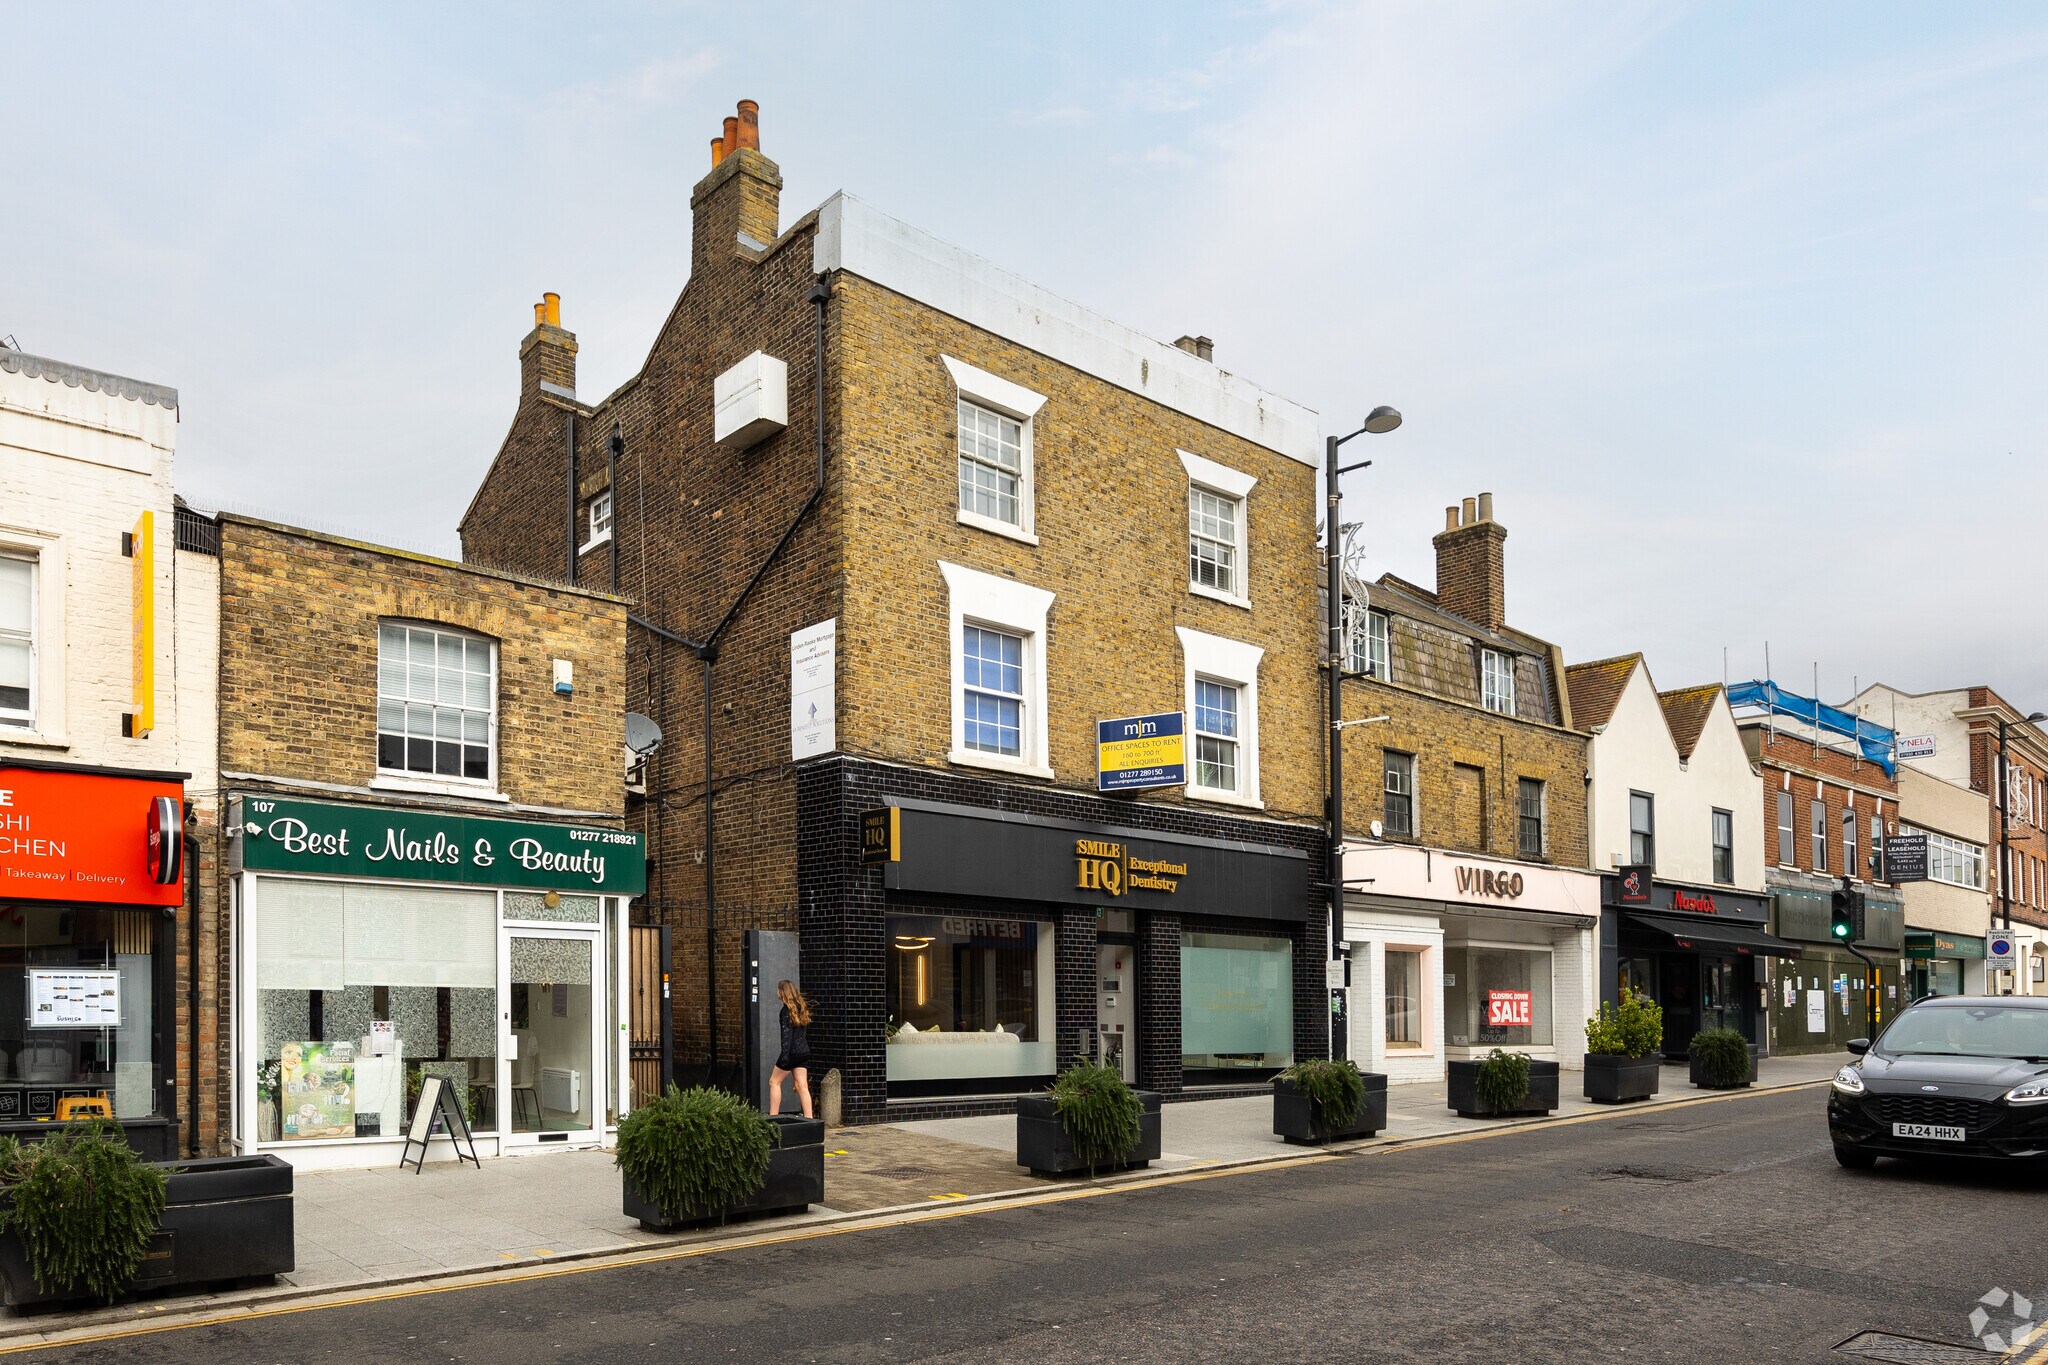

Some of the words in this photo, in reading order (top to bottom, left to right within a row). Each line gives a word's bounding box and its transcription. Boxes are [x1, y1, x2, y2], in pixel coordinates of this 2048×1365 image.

[1102, 744, 1124, 752] OFFICE
[1126, 742, 1150, 750] SPACES
[1163, 738, 1181, 746] RENT
[1907, 738, 1932, 747] NELA
[1119, 760, 1129, 768] ALL
[1131, 757, 1164, 767] ENQUIRIES
[1120, 770, 1138, 778] 01277
[1140, 768, 1163, 777] 289150
[252, 801, 276, 814] 107
[866, 816, 885, 827] SMILE
[570, 830, 600, 843] 01277
[602, 832, 637, 846] 218921
[866, 828, 885, 846] HQ
[268, 817, 350, 857] Best
[365, 828, 460, 865] Nails
[473, 839, 497, 867] &
[509, 838, 606, 884] Beauty
[1076, 839, 1120, 858] SMILE
[1128, 856, 1188, 876] Exceptional
[6, 867, 66, 882] Takeaway
[76, 872, 126, 886] Delivery
[1076, 858, 1121, 896] HQ
[1128, 874, 1178, 893] Dentistry
[1454, 866, 1524, 898] VIRGO
[1673, 890, 1715, 913] Nando's
[1936, 938, 1955, 950] Dyas
[1492, 992, 1513, 1000] CLOSING
[1491, 1001, 1528, 1023] SALE
[1898, 1124, 1932, 1137] EA24
[1934, 1127, 1960, 1139] HHX
